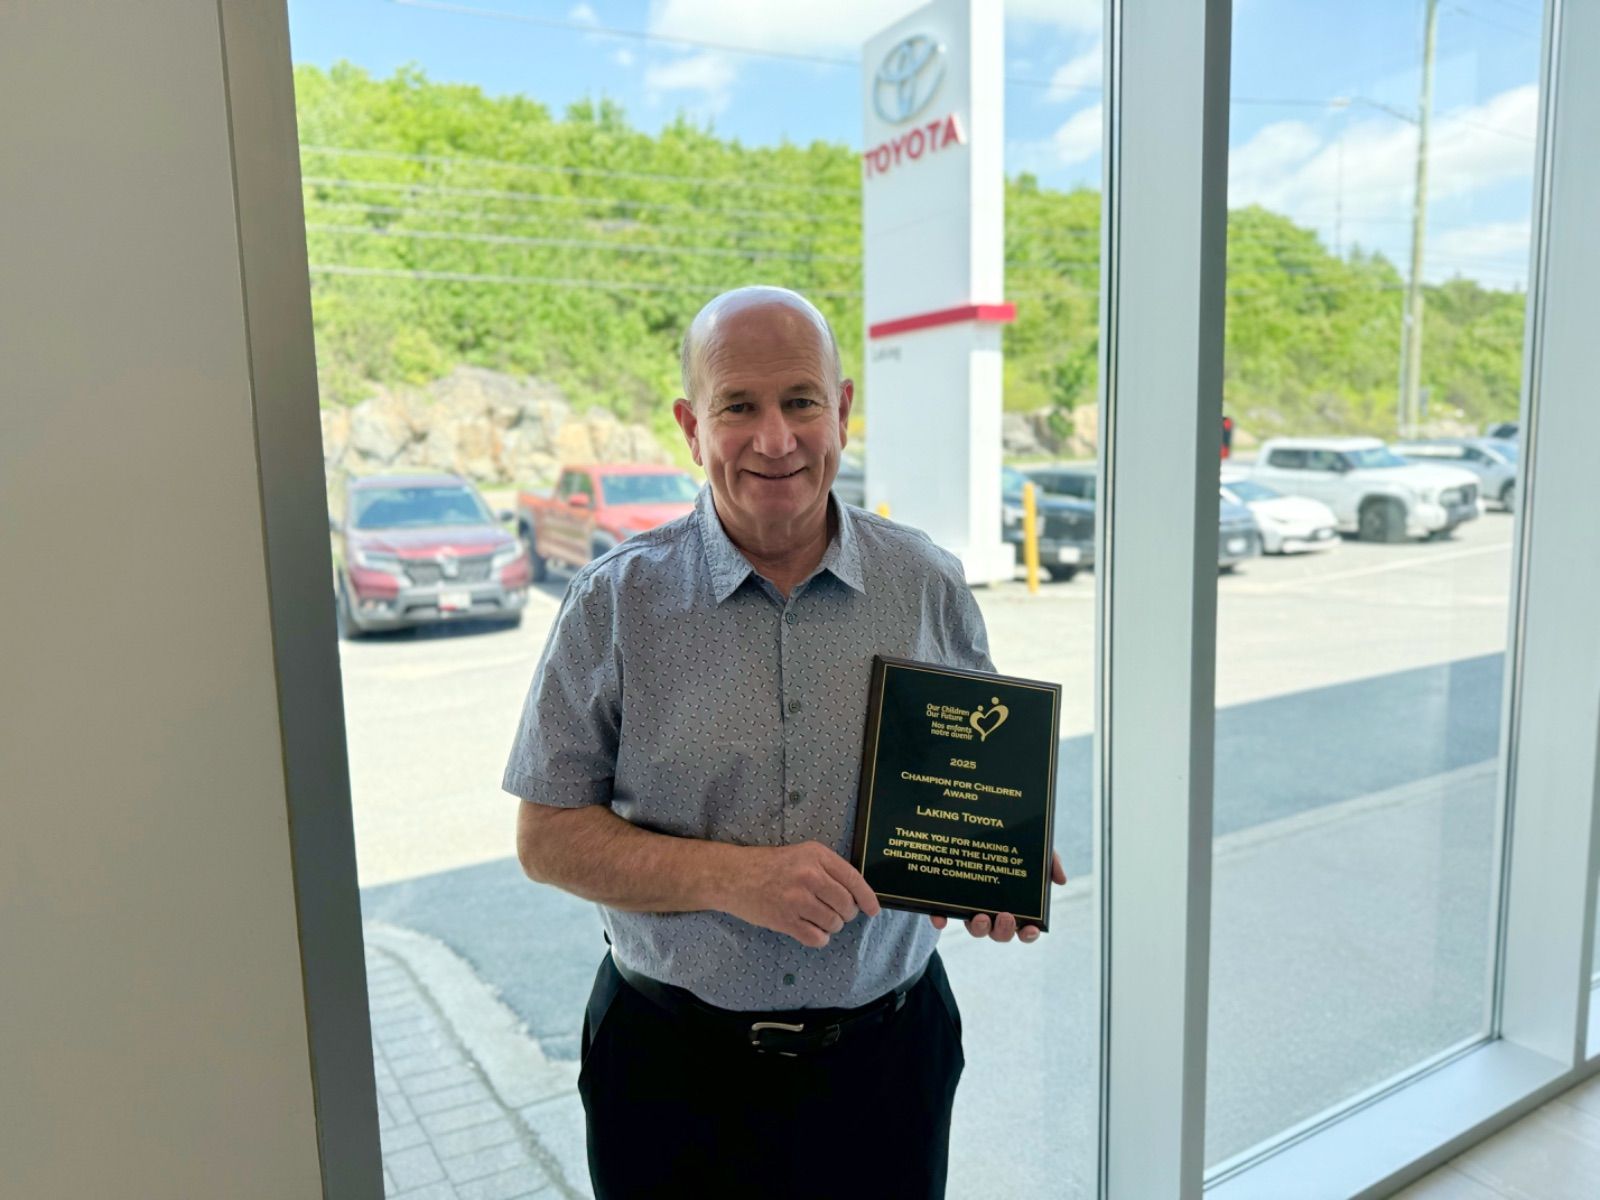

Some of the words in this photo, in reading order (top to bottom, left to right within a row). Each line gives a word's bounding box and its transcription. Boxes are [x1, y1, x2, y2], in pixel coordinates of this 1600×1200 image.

[863, 112, 962, 180] TOYOTA
[926, 710, 939, 718] Our
[941, 712, 963, 722] Future
[927, 703, 940, 711] Our
[941, 705, 970, 716] Children
[931, 729, 950, 737] notre
[932, 722, 945, 730] Nos
[946, 724, 972, 734] enfants
[950, 758, 976, 769] 2025
[901, 772, 951, 786] CHAMPION
[953, 780, 972, 790] FOR
[974, 783, 1022, 798] CHILDREN
[943, 789, 978, 801] AWARD
[916, 805, 960, 821] LAKING
[962, 812, 1004, 828] TOYOTA
[896, 827, 929, 839] THANK
[931, 833, 950, 843] YOU
[951, 837, 970, 846] FOR
[972, 840, 1009, 853] MAKING
[889, 838, 948, 854] DIFFERENCE
[961, 849, 980, 859] THE
[982, 852, 1008, 864] LIVES
[1010, 857, 1024, 865] OF
[883, 848, 931, 863] CHILDREN
[933, 856, 953, 866] AND
[955, 860, 983, 871] THEIR
[985, 865, 1027, 877] FAMILIES
[908, 863, 918, 871] IN
[920, 866, 941, 876] OUR
[942, 868, 1000, 884] COMMUNITY.
